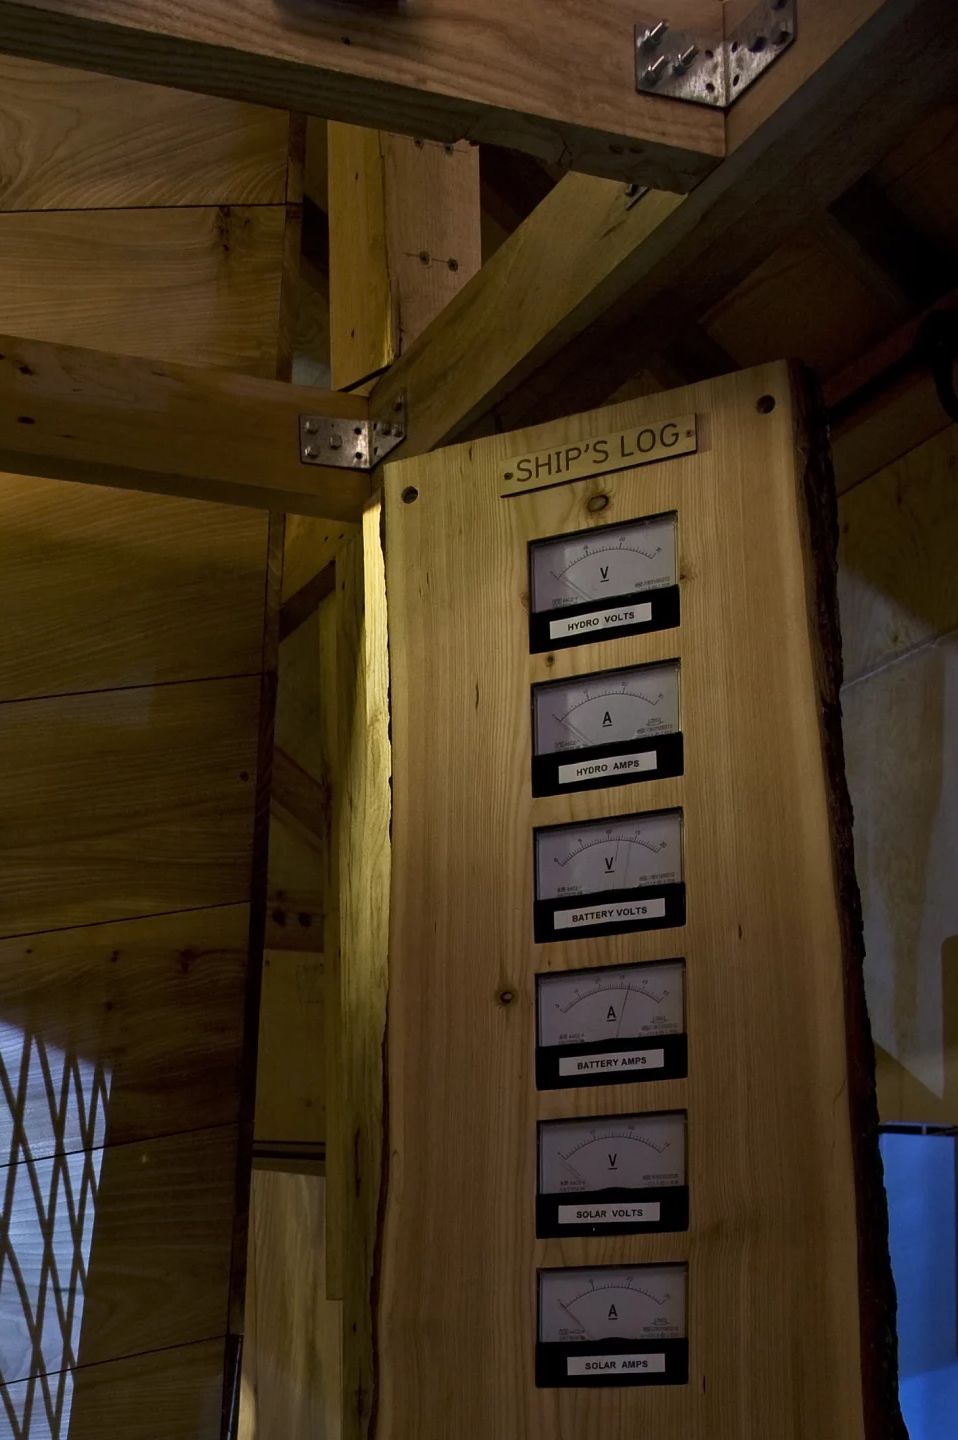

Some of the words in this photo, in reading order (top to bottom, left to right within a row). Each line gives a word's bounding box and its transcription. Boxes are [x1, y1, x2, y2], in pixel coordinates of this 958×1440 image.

[516, 439, 610, 483] SHIP'S
[620, 423, 680, 458] LOG
[600, 565, 609, 580] V
[567, 617, 600, 631] HYDRO
[604, 611, 635, 623] VOLTS
[602, 711, 612, 725] A
[576, 764, 608, 776] HYDRO
[613, 759, 640, 771] AMPS
[605, 856, 614, 870] V
[571, 909, 614, 923] BATTERY
[616, 906, 648, 917] VOLTS
[606, 1005, 617, 1019] A
[577, 1058, 619, 1070] BATTERY
[621, 1056, 647, 1066] AMPS
[608, 1153, 618, 1167] V
[576, 1210, 607, 1219] SOLAR
[612, 1208, 643, 1217] VOLTS
[608, 1303, 618, 1318] A
[585, 1361, 616, 1370] SOLAR
[621, 1360, 648, 1369] AMPS
